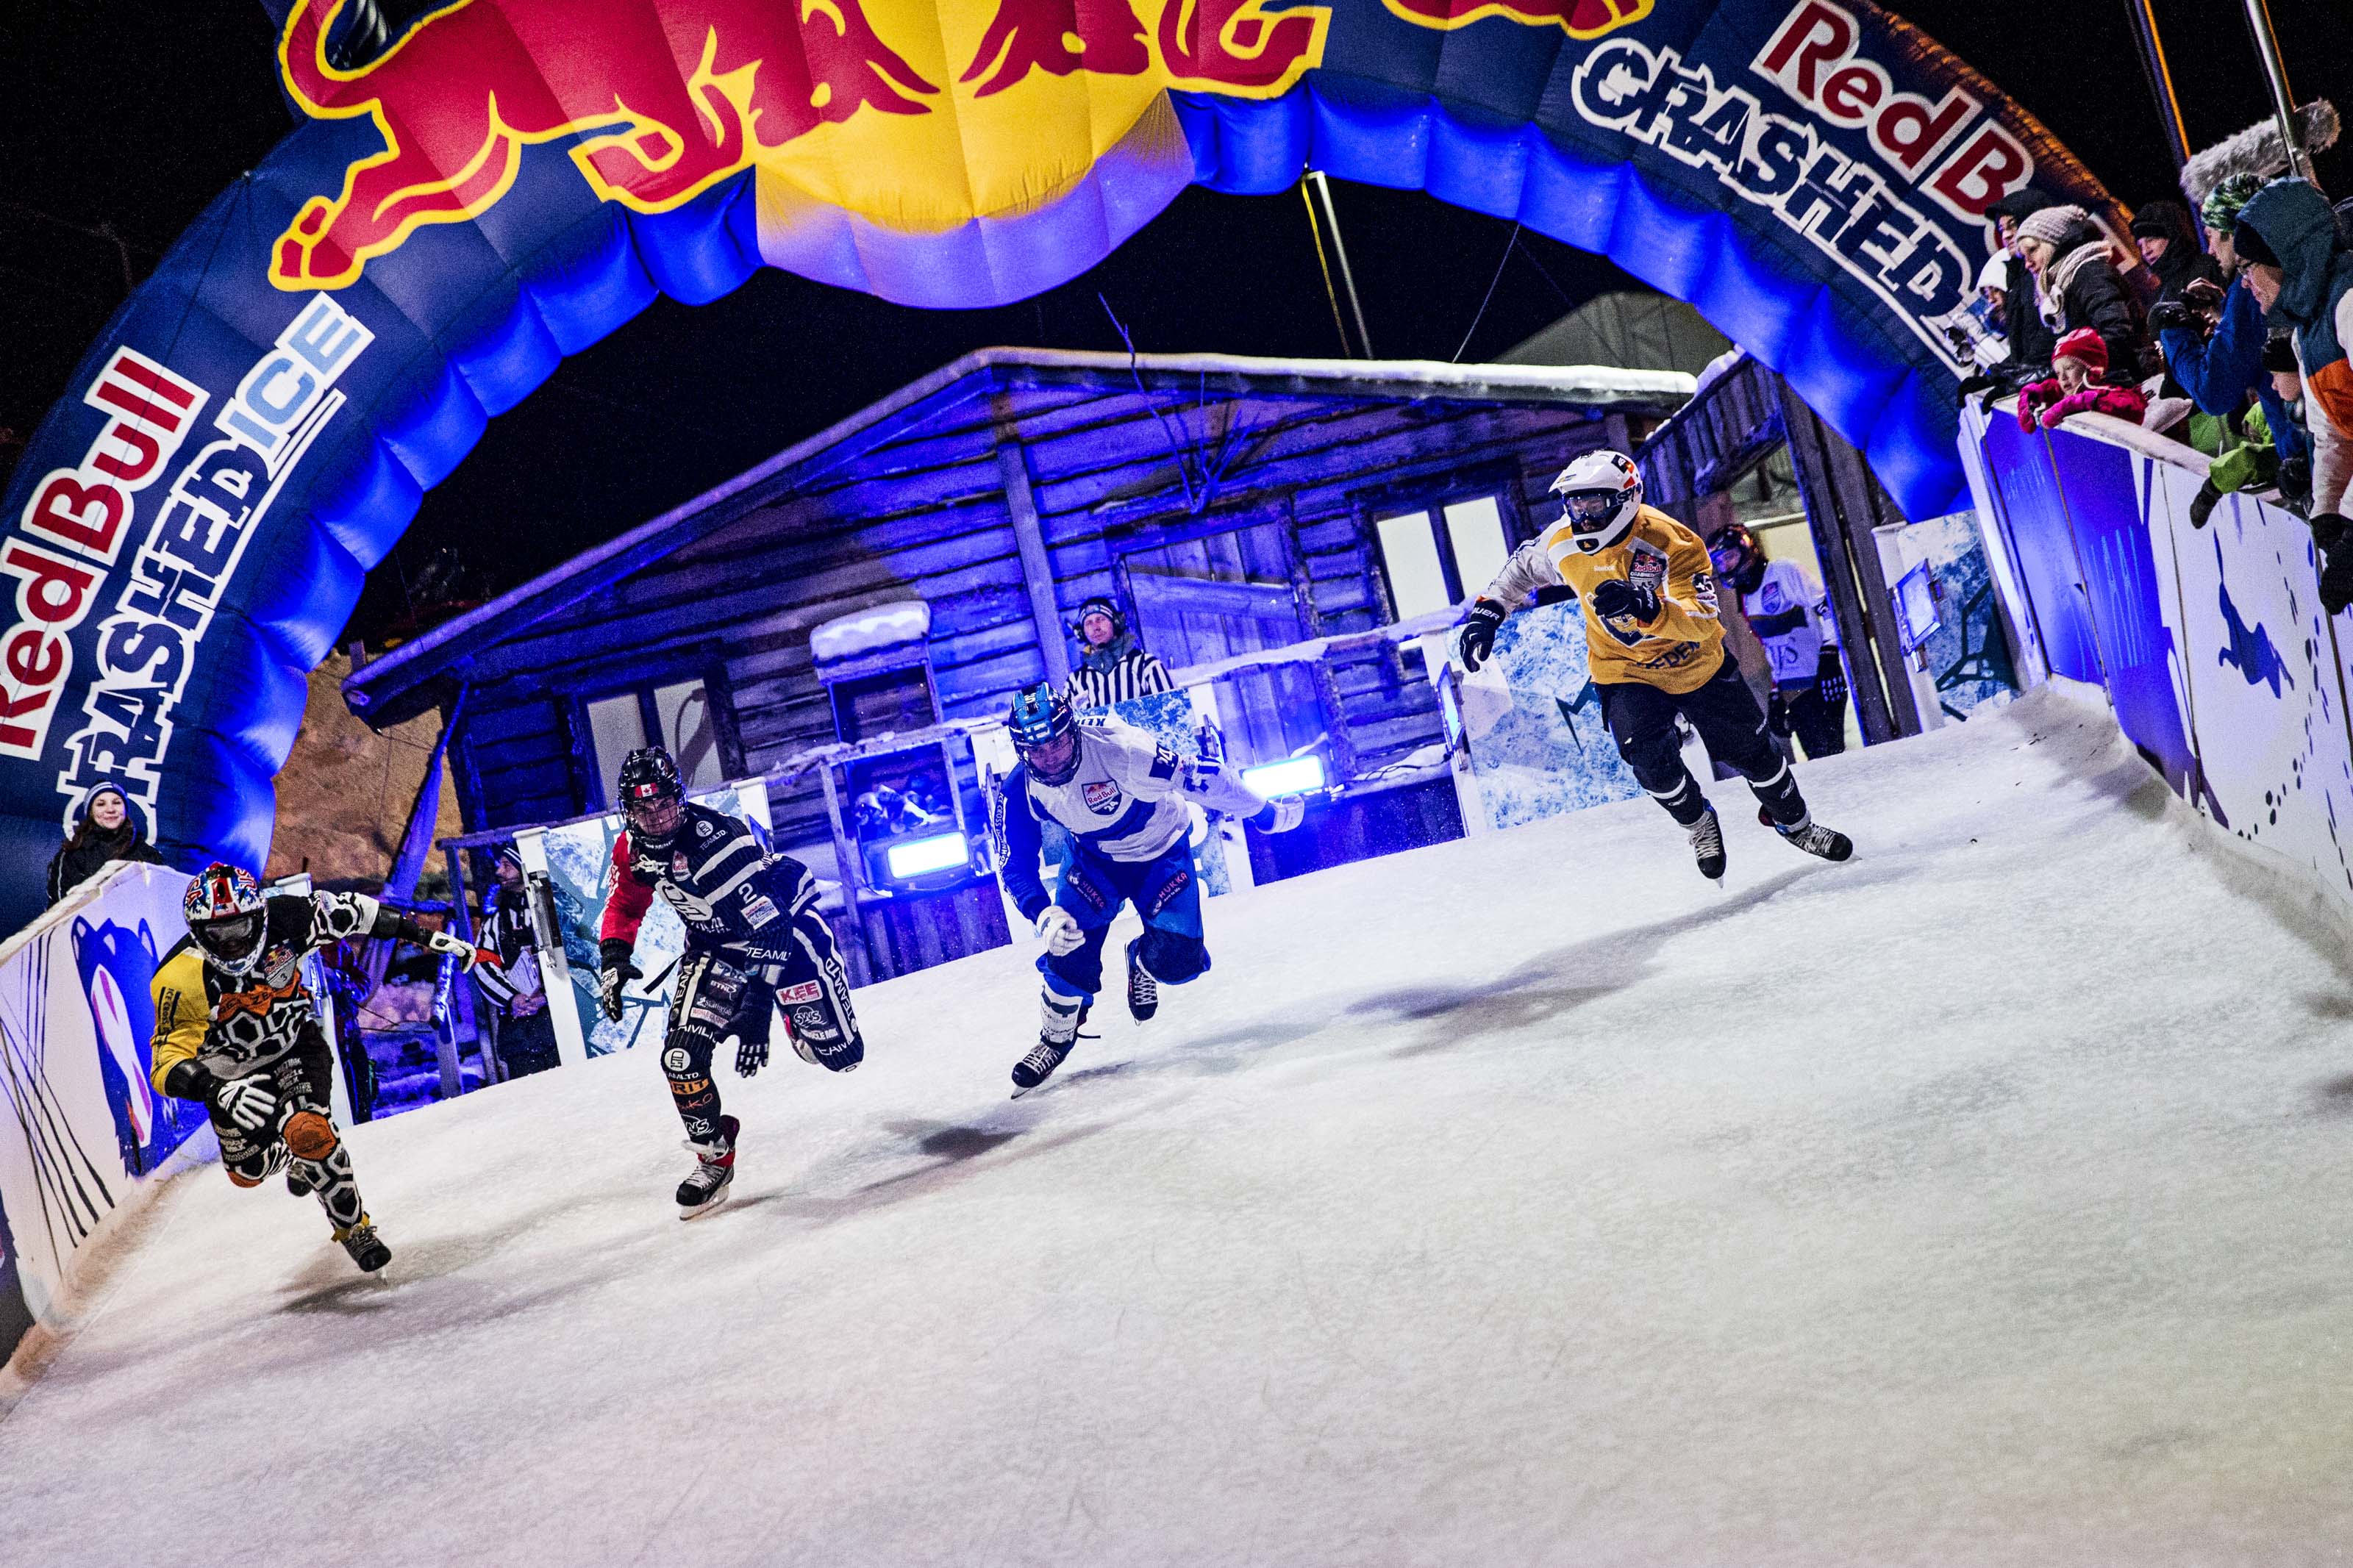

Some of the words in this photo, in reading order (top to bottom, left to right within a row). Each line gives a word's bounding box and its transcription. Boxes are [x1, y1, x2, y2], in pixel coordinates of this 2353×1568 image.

[1572, 38, 1972, 319] CRASHED
[1759, 0, 1978, 176] Red
[26, 351, 204, 560] Bull
[57, 440, 278, 845] RASHED
[219, 293, 372, 451] ICE
[1088, 793, 1102, 804] Red
[1101, 787, 1116, 798] Bull
[1158, 872, 1188, 899] HUKKA
